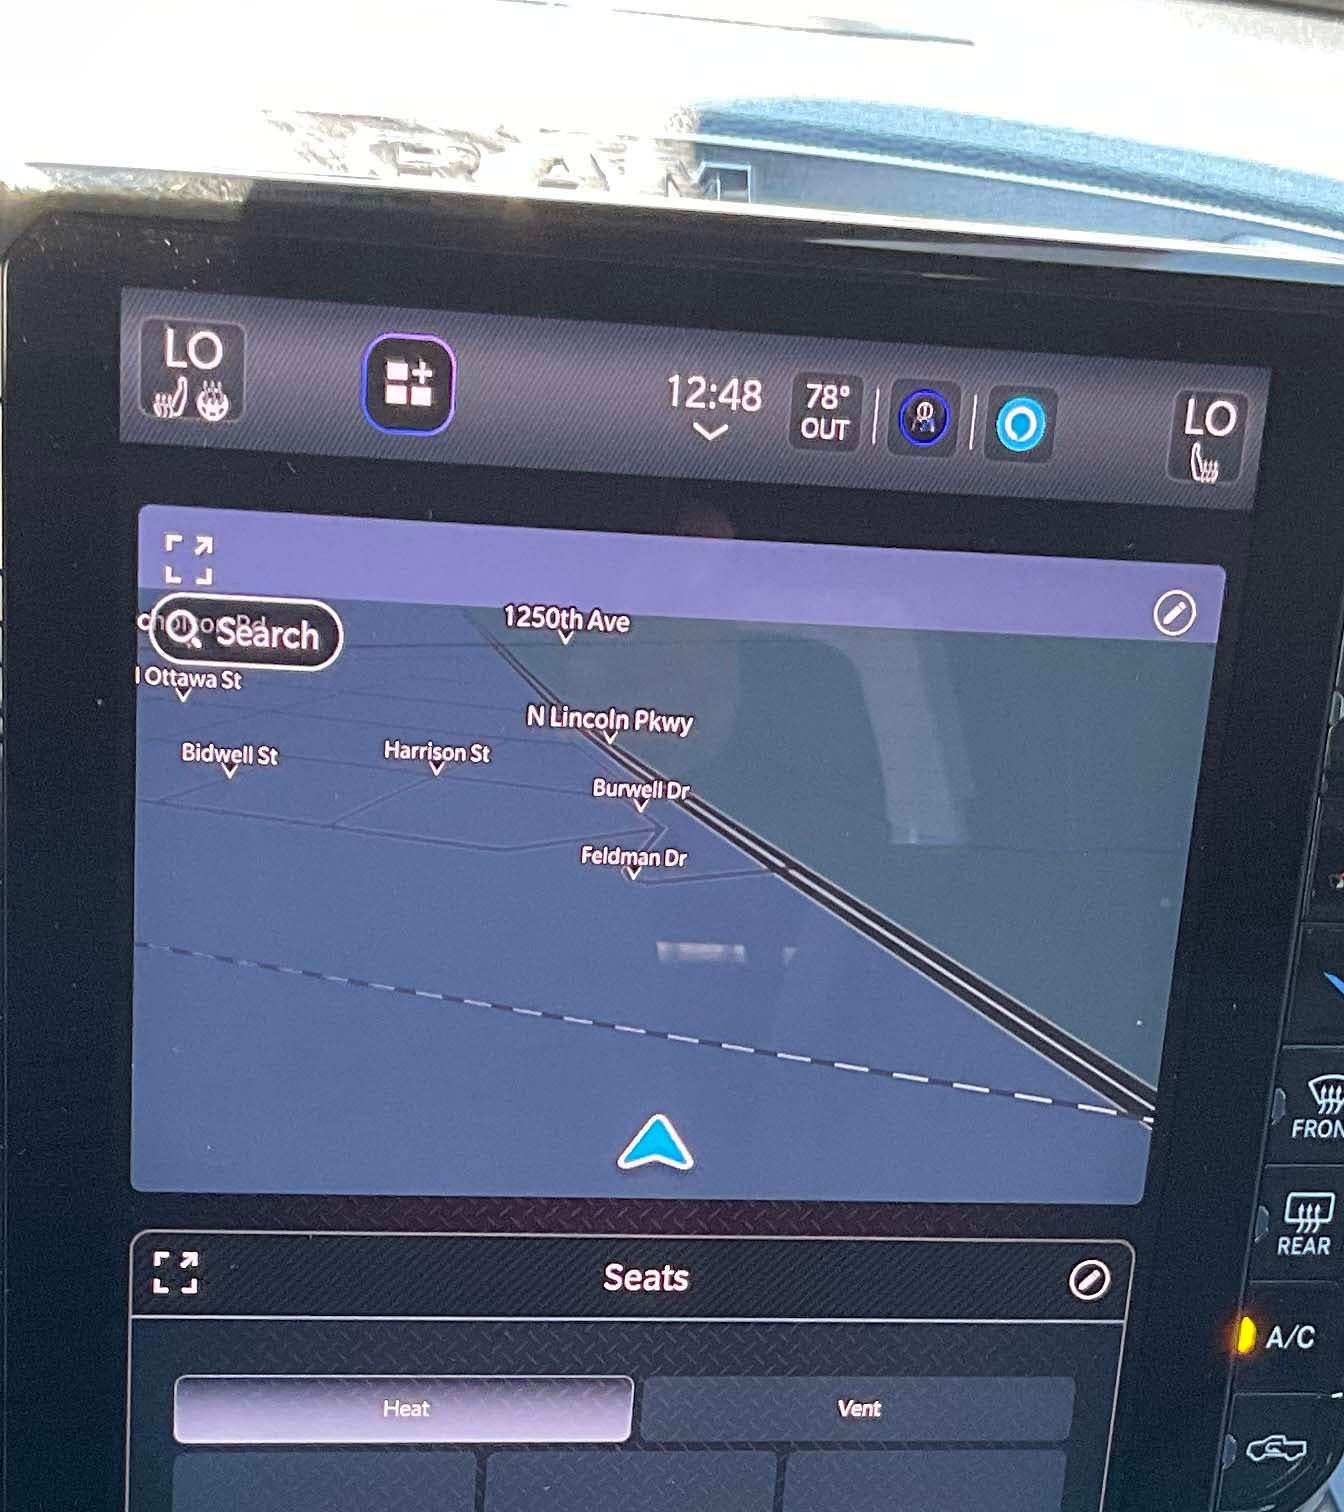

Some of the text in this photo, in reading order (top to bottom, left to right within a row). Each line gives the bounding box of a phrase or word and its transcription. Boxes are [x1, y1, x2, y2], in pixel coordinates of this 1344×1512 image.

[166, 333, 222, 369] LO
[668, 375, 761, 411] 12:48
[806, 383, 850, 410] 78°
[801, 417, 851, 440] OUT
[1185, 400, 1234, 437] LO
[504, 605, 630, 633] 1250th Ave
[217, 617, 320, 649] Search
[145, 667, 217, 688] Ottawa
[221, 671, 242, 690] St
[528, 705, 693, 737] N Lincoln Pkwy
[182, 743, 278, 766] Bidwell St
[384, 741, 491, 763] Harrison St
[593, 779, 690, 800] Burwell Dr
[581, 846, 687, 868] Feldman Dr
[1277, 1237, 1331, 1256] REAR
[602, 1263, 689, 1293] Seats
[1265, 1325, 1316, 1349] A/C
[382, 1399, 429, 1418] Heat
[837, 1399, 880, 1418] Vent
